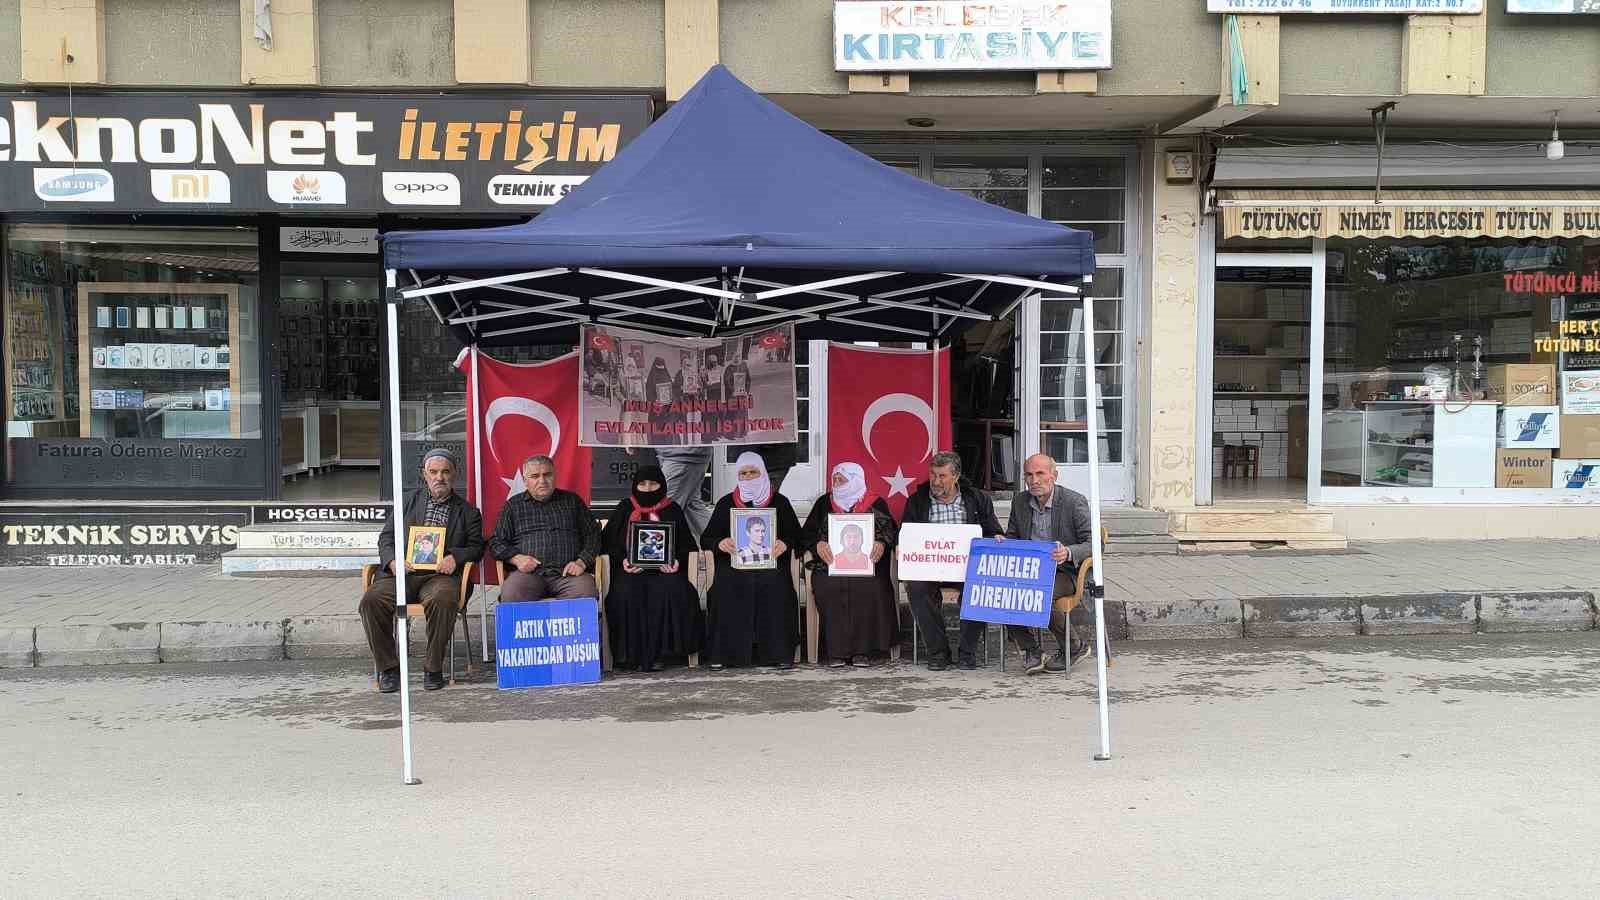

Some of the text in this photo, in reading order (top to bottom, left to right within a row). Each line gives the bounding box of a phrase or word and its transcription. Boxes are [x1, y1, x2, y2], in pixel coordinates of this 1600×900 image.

[0, 101, 620, 172] knoNet İLETİŞİM
[394, 183, 449, 193] oppo
[493, 181, 554, 196] TEKNİK
[1242, 208, 1322, 231] TÜTÜNCÜ
[1340, 207, 1392, 231] NİMET
[1496, 208, 1551, 231] TÜTÜN
[1503, 271, 1577, 293] TÜTÜNCÜ
[1560, 320, 1587, 334] HER
[1534, 336, 1580, 352] TÜTÜN
[38, 440, 248, 457] Fatura Ödeme Merkezi
[269, 507, 386, 521] HOŞGELDİNİZ
[3, 525, 239, 545] TEKNİK SERVİS
[924, 540, 956, 550] EVLAT
[47, 554, 121, 566] TELEFON
[133, 554, 196, 566] TABLET
[976, 554, 1041, 580] ANNELER
[970, 581, 1044, 612] DİRENİYOR
[515, 620, 545, 639] ARTIK
[546, 617, 576, 637] YETER
[498, 638, 600, 668] YAKAMIZDAN DÜŞÜN
